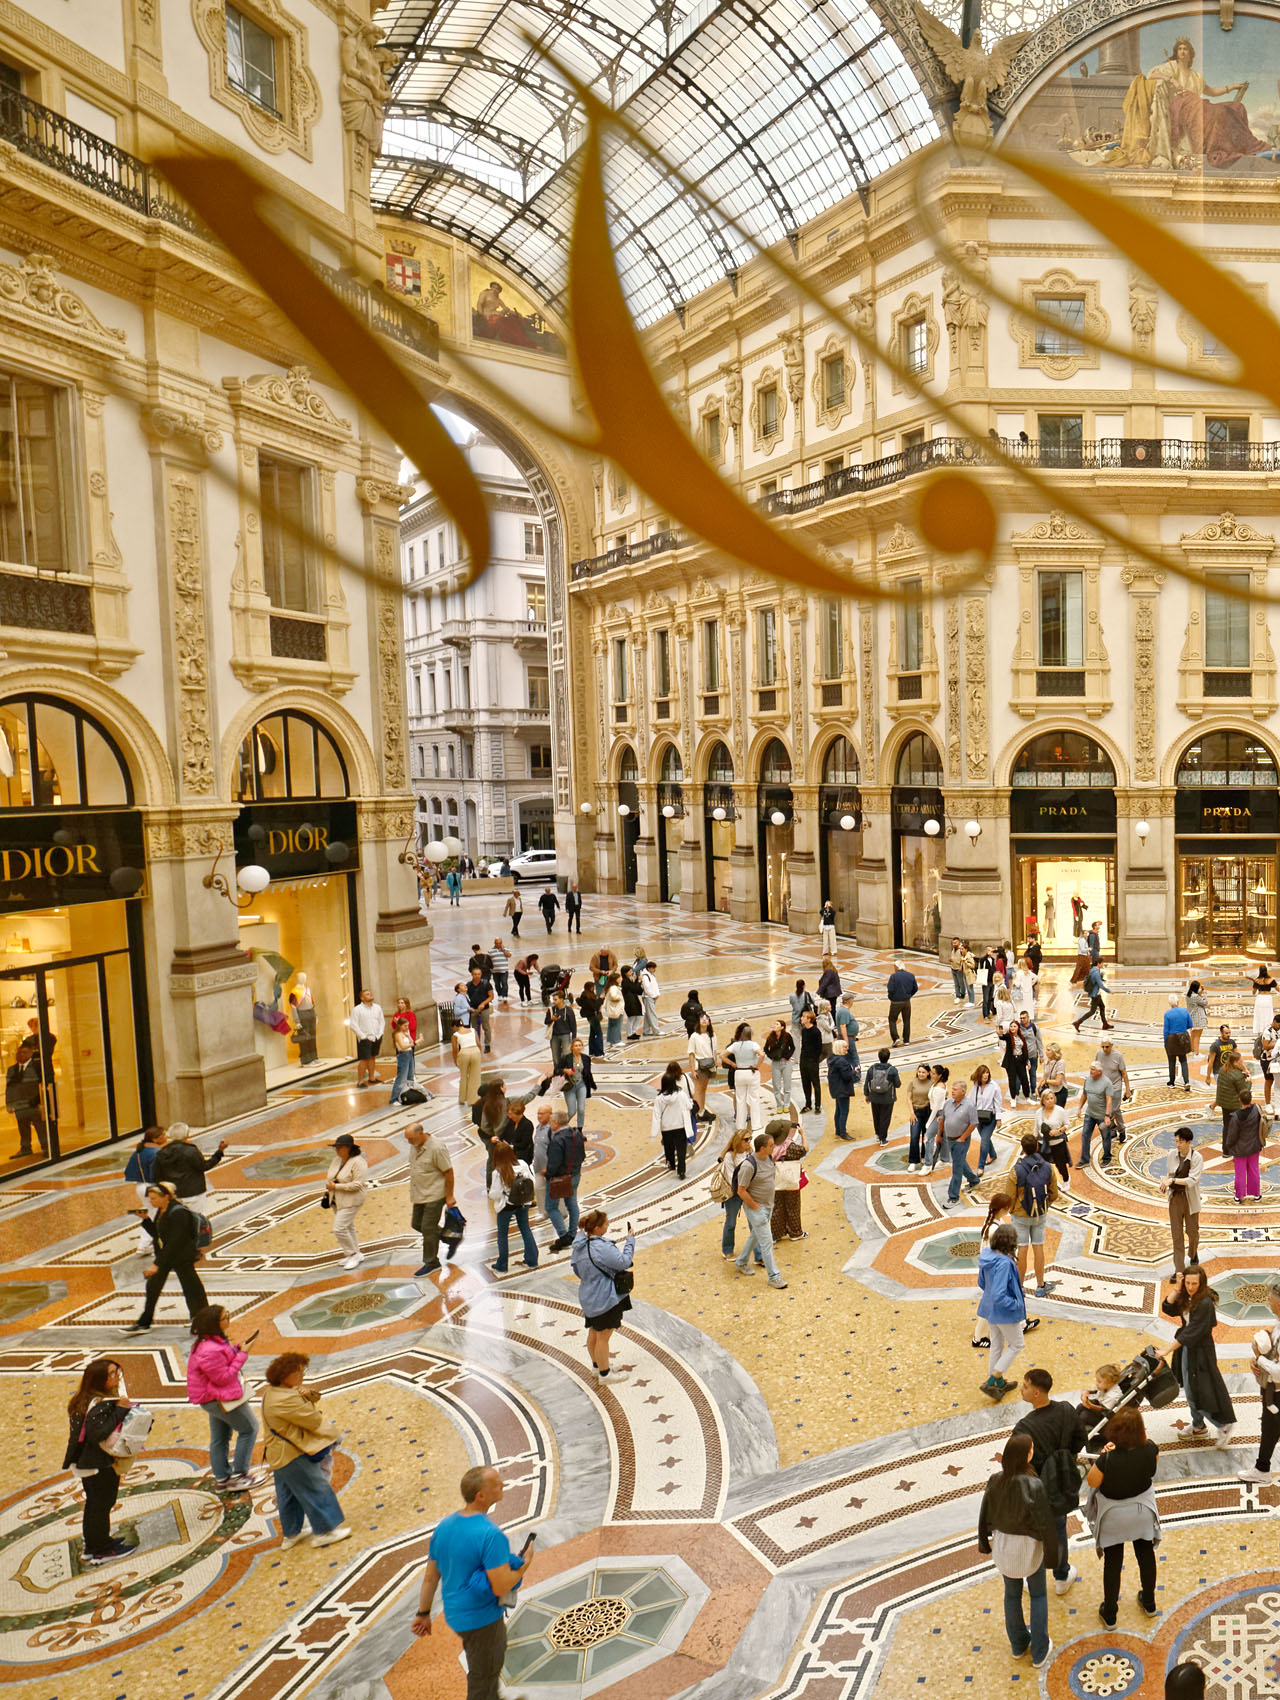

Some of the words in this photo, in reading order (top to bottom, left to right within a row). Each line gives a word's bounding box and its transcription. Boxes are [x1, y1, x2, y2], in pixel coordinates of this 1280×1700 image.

[1039, 806, 1088, 816] PRADA
[1203, 807, 1252, 817] PRADA
[266, 826, 329, 856] DIOR
[1, 844, 102, 882] DIOR
